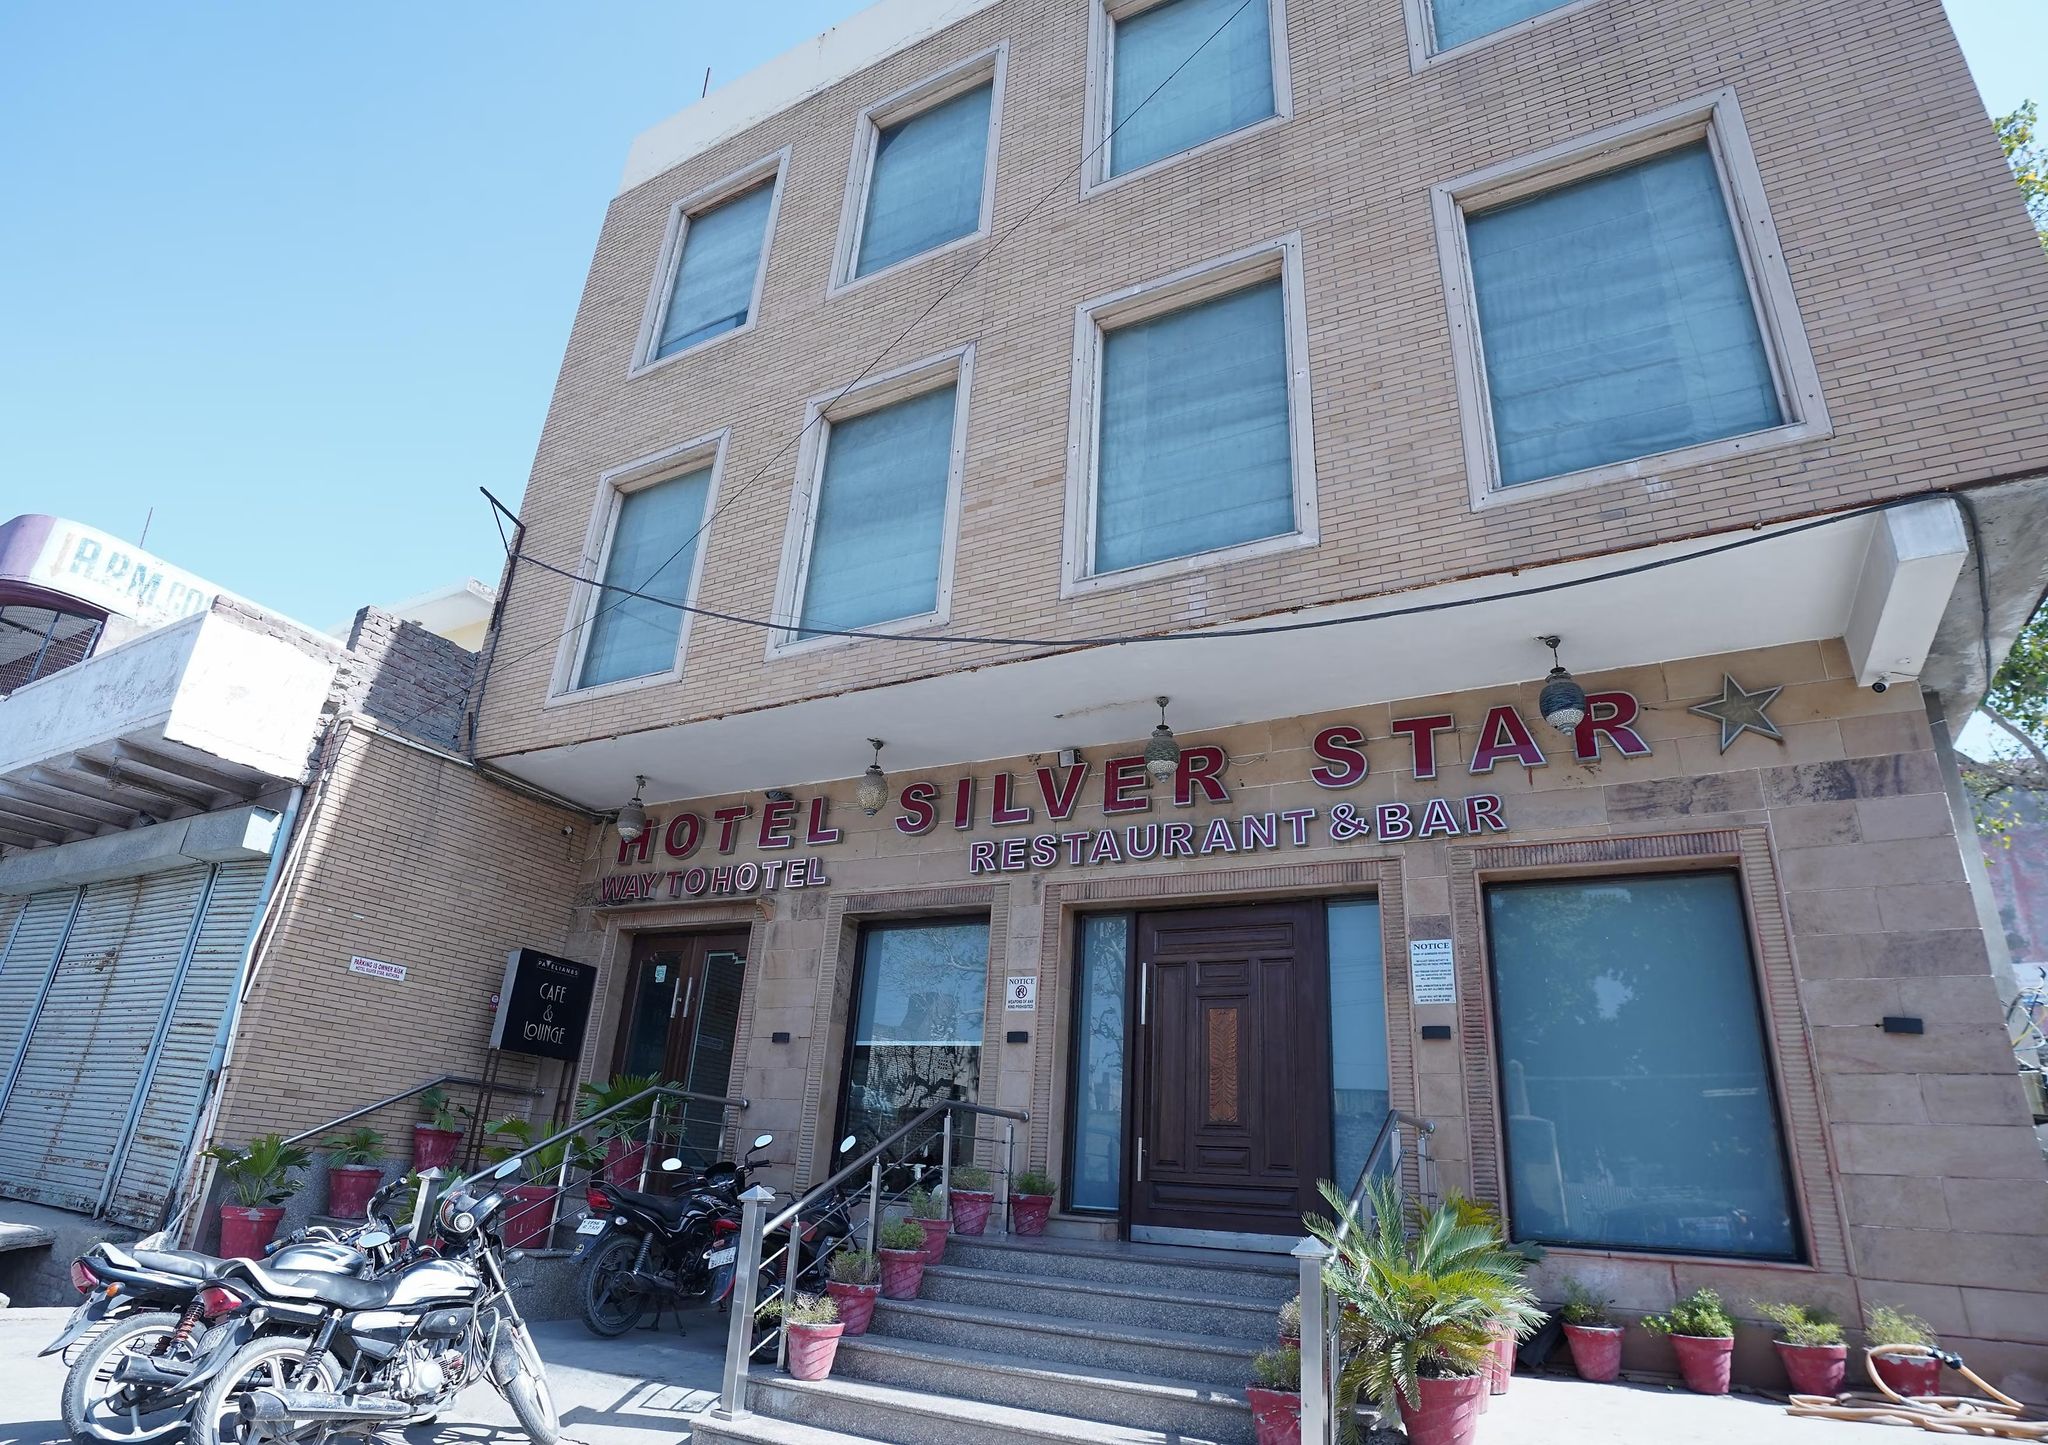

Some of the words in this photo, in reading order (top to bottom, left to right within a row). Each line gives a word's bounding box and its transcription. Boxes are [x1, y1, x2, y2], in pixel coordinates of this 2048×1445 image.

[616, 794, 843, 866] HOTEL
[894, 746, 1232, 837] SILVER
[1309, 690, 1653, 790] STAR
[968, 806, 1317, 875] RESTAURANT
[601, 869, 661, 903] WAY
[664, 866, 709, 897] TO
[709, 856, 832, 894] HOTEL
[1414, 942, 1450, 950] NOTICE
[353, 958, 373, 968] PARKING
[539, 982, 567, 1003] CAFE
[543, 1004, 554, 1023] &
[523, 1020, 566, 1044] LOUNGE
